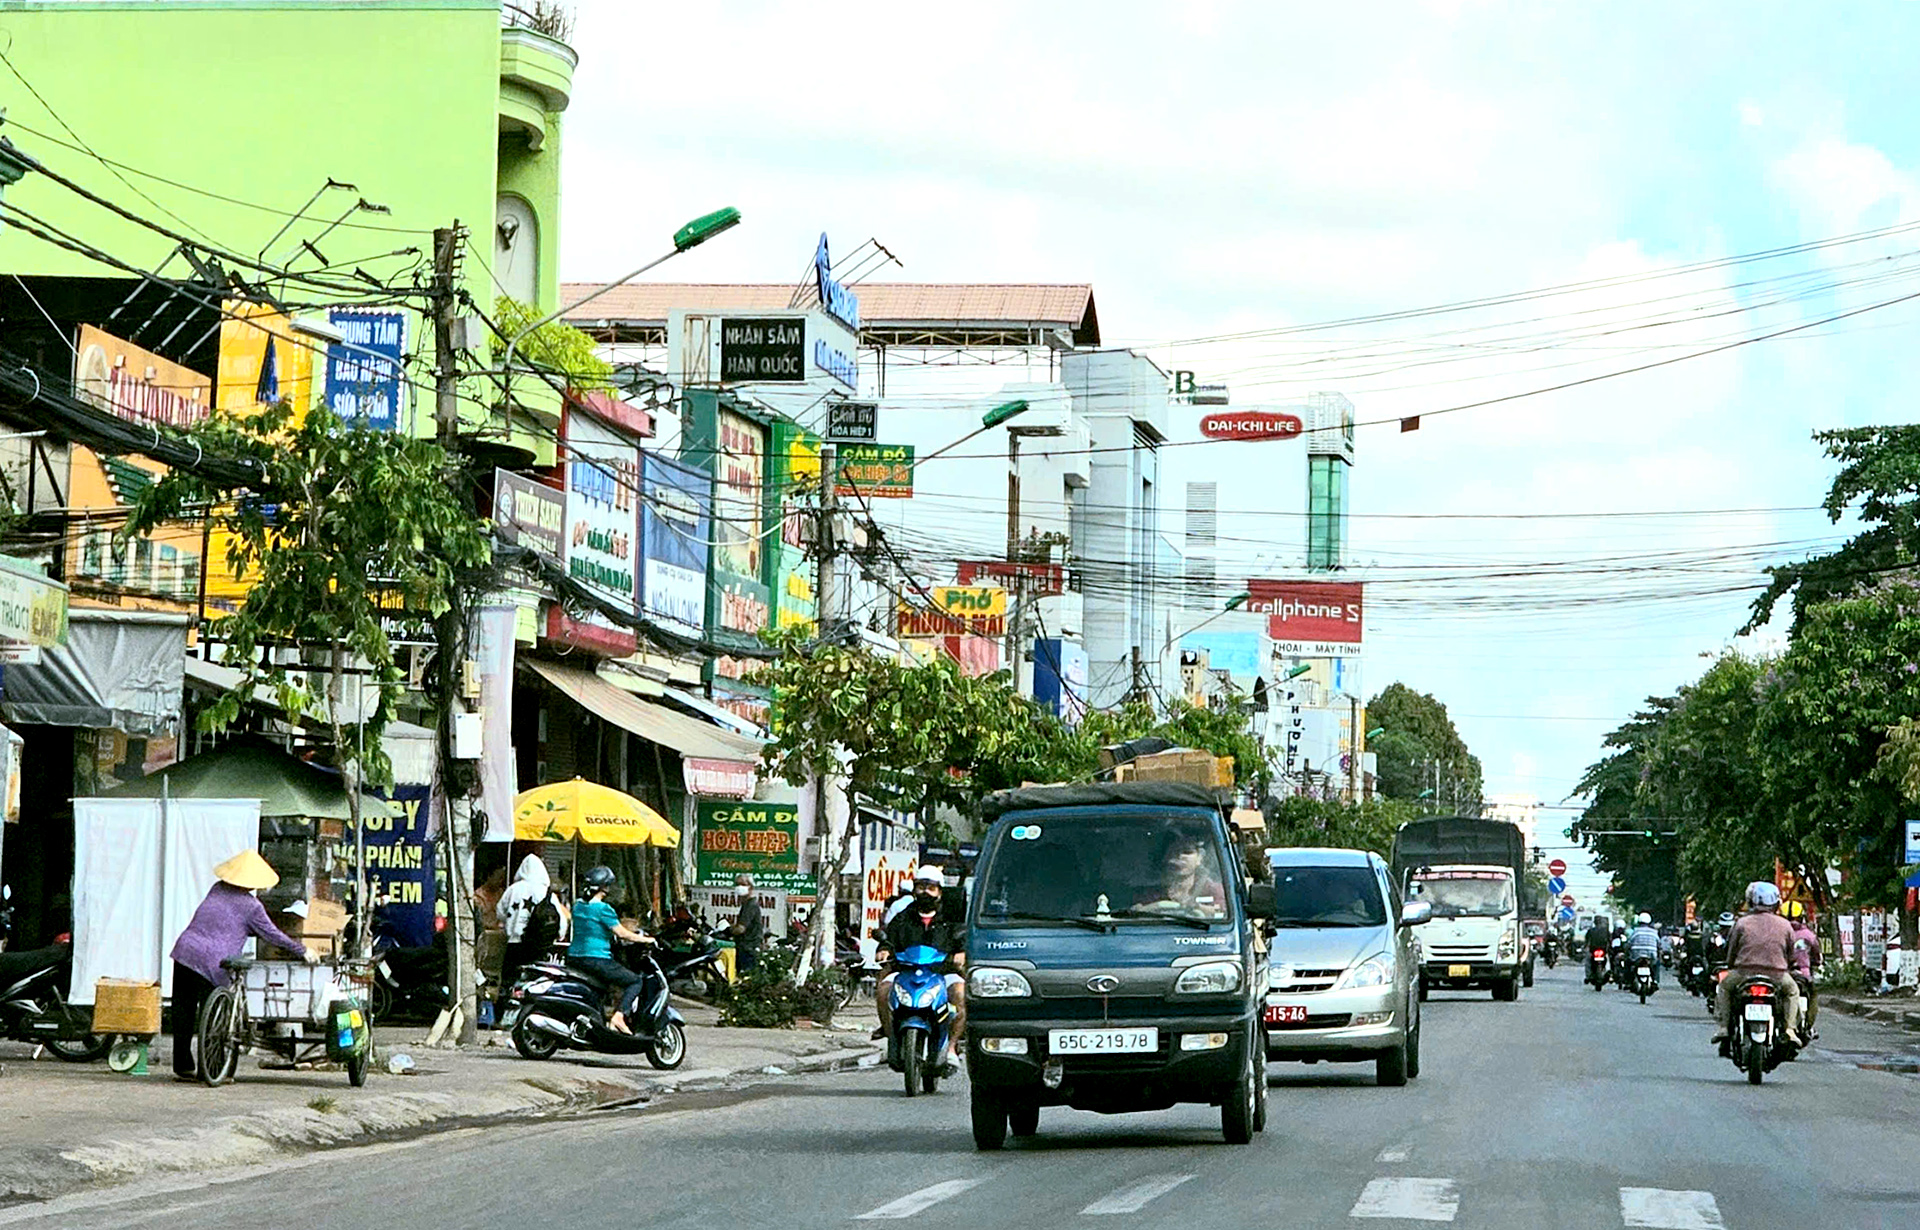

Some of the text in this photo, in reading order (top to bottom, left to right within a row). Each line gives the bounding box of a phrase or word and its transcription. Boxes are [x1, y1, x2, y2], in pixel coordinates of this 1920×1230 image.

[374, 317, 398, 346] TÂM
[1208, 421, 1295, 431] DAI-ICHI LIFE
[945, 587, 992, 611] Phở
[1251, 598, 1341, 621] cellphone
[366, 837, 423, 868] PHẨM
[785, 873, 808, 881] CAO
[1173, 936, 1227, 946] TOWNER
